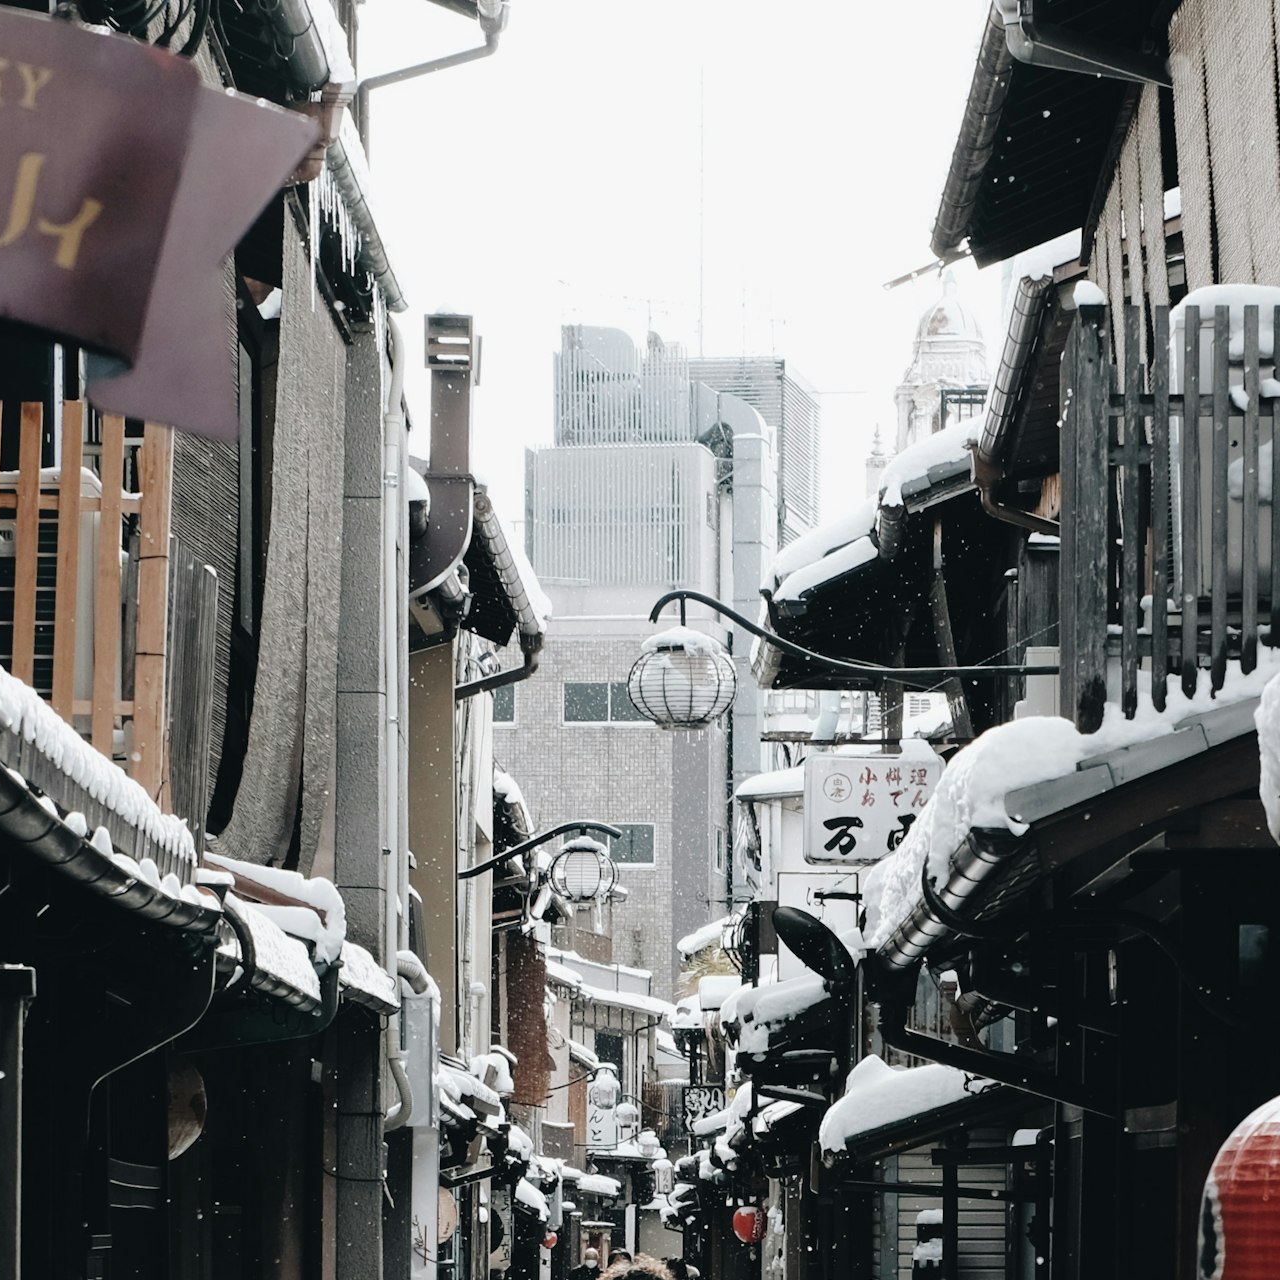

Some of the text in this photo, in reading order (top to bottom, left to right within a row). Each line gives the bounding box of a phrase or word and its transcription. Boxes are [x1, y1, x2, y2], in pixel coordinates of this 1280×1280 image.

[859, 766, 928, 786] 小料理
[861, 788, 929, 808] おでん
